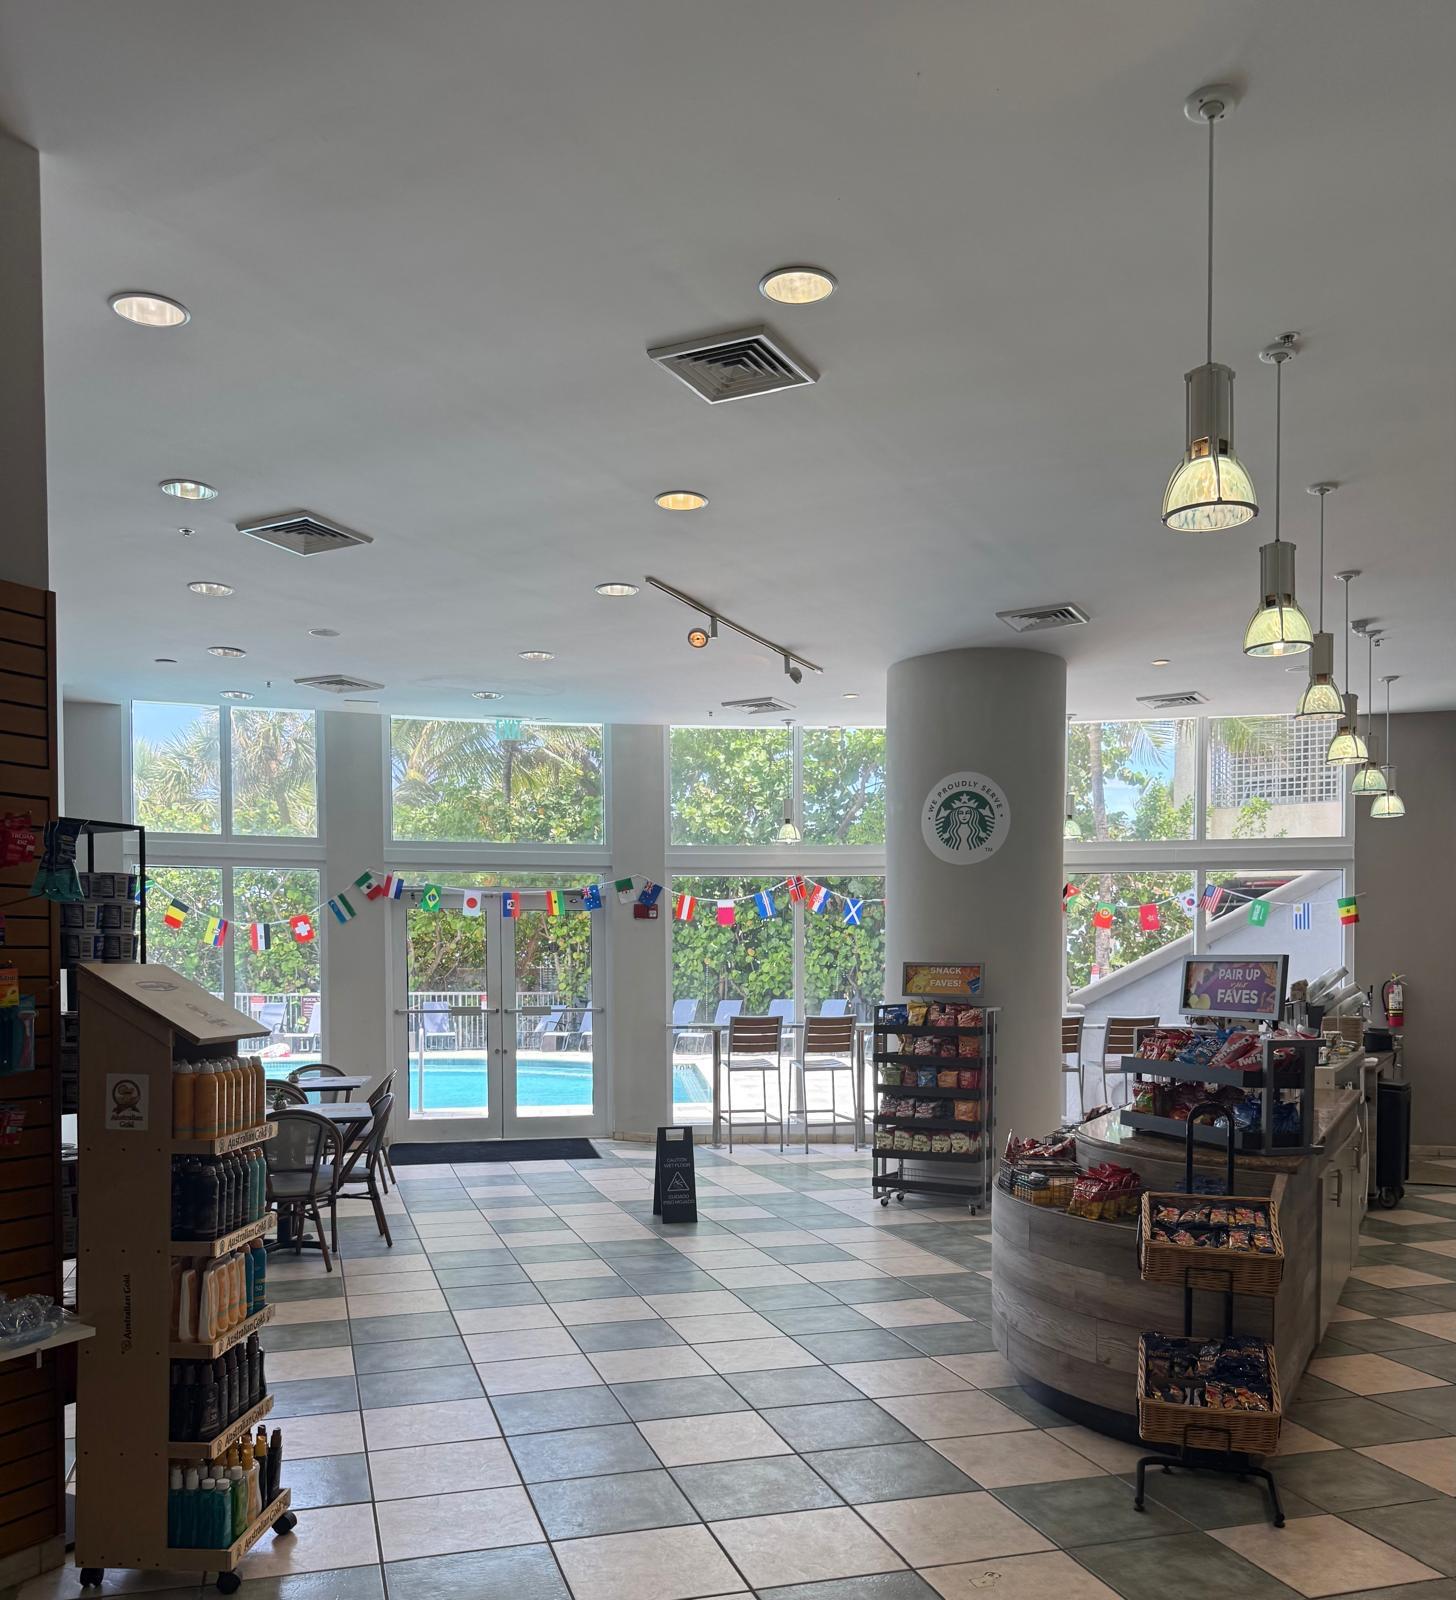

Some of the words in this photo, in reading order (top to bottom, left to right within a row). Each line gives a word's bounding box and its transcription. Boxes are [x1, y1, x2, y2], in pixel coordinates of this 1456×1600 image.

[496, 719, 522, 740] EXIT
[928, 799, 938, 813] WE
[937, 780, 978, 798] PROUDLY
[980, 785, 1003, 809] SERVE
[930, 967, 962, 975] SNACK
[1218, 968, 1243, 980] PAIR
[1245, 968, 1261, 980] UP
[930, 979, 962, 987] FAVES!
[1216, 989, 1258, 1004] FAVES
[110, 1112, 144, 1121] Australian
[227, 1132, 255, 1149] Australian
[255, 1128, 268, 1141] Gold
[227, 1228, 255, 1249] Australian
[254, 1219, 267, 1237] Gold
[122, 1273, 131, 1294] Gold
[123, 1294, 132, 1340] Australian
[226, 1323, 254, 1349] Australian
[253, 1315, 266, 1330] Gold
[225, 1418, 252, 1447] Australian
[251, 1407, 264, 1424] Gold
[243, 1516, 270, 1551] Australian
[269, 1502, 283, 1522] Gold
